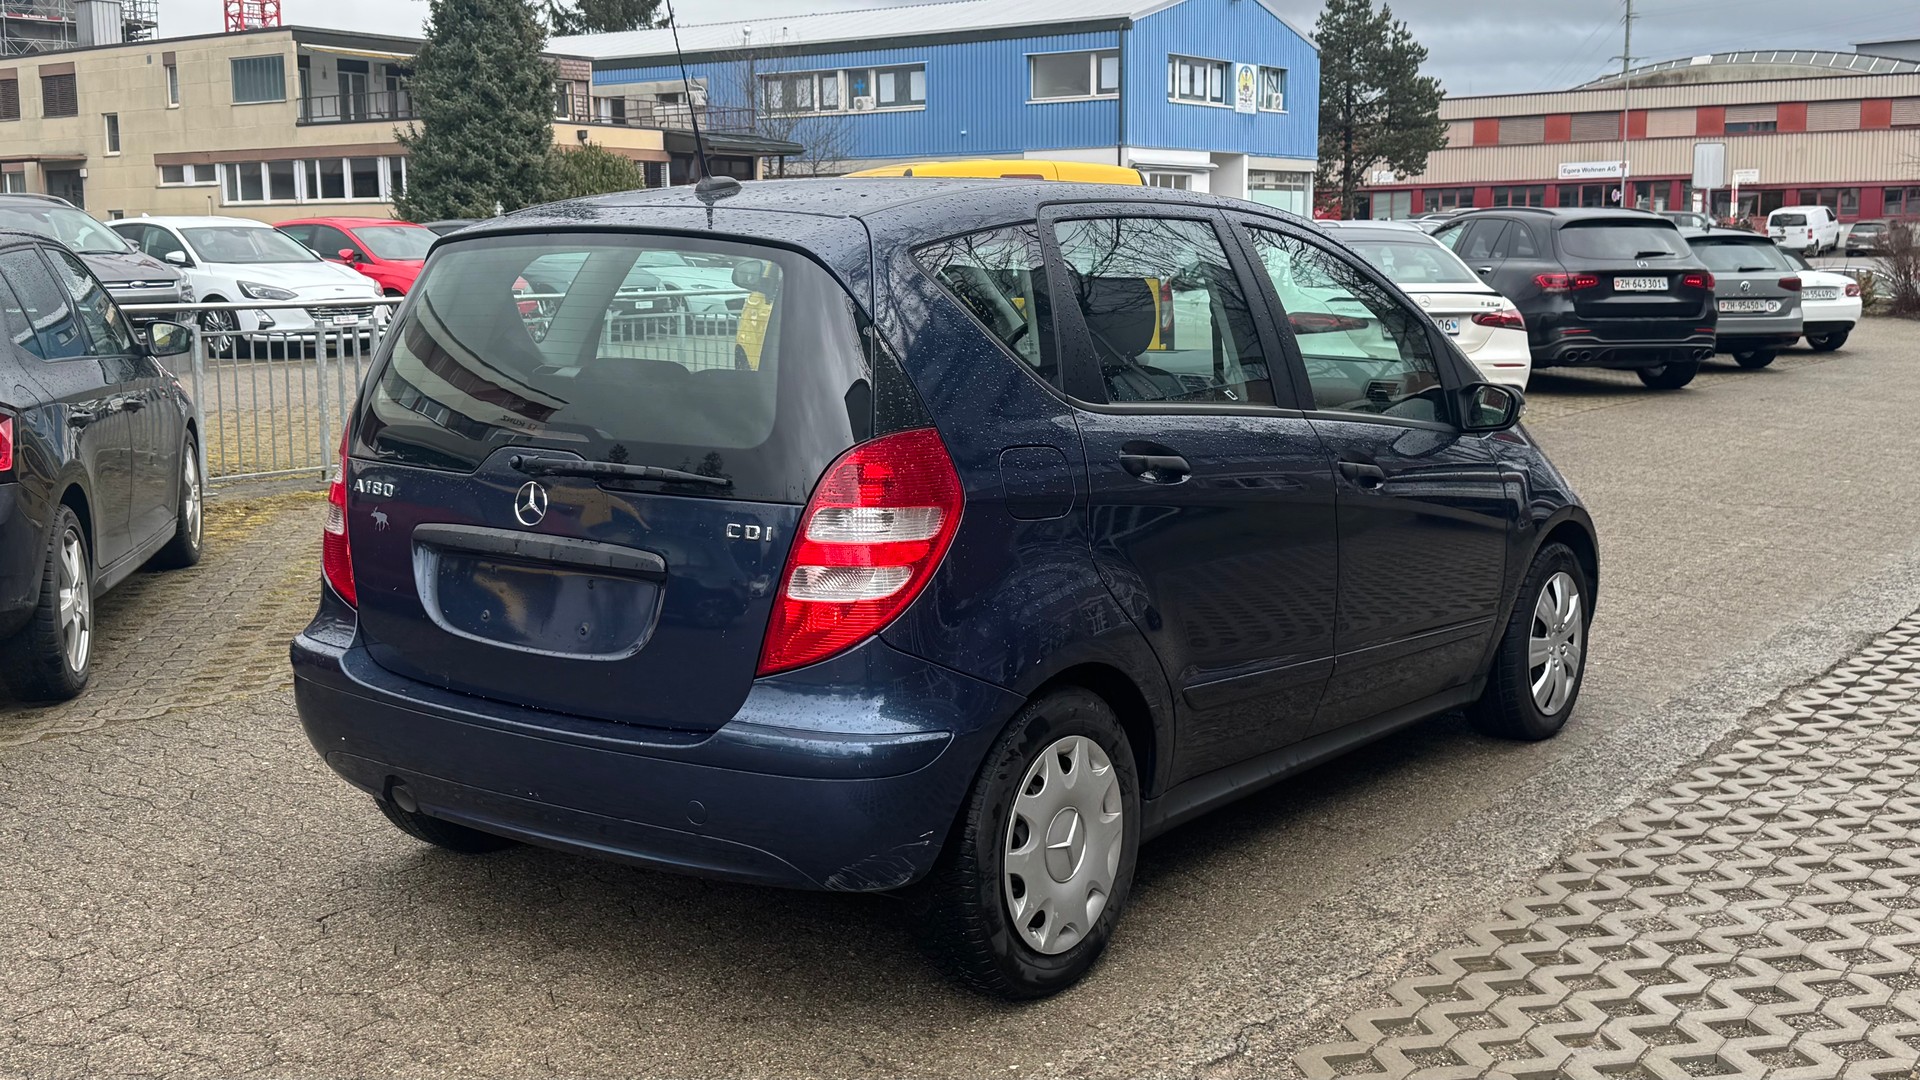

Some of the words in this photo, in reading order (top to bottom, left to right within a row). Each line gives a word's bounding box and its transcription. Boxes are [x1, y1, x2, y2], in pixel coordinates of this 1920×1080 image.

[1620, 279, 1630, 288] ZH
[1726, 301, 1735, 310] ZH
[353, 478, 395, 498] A180
[726, 523, 772, 541] CDI
